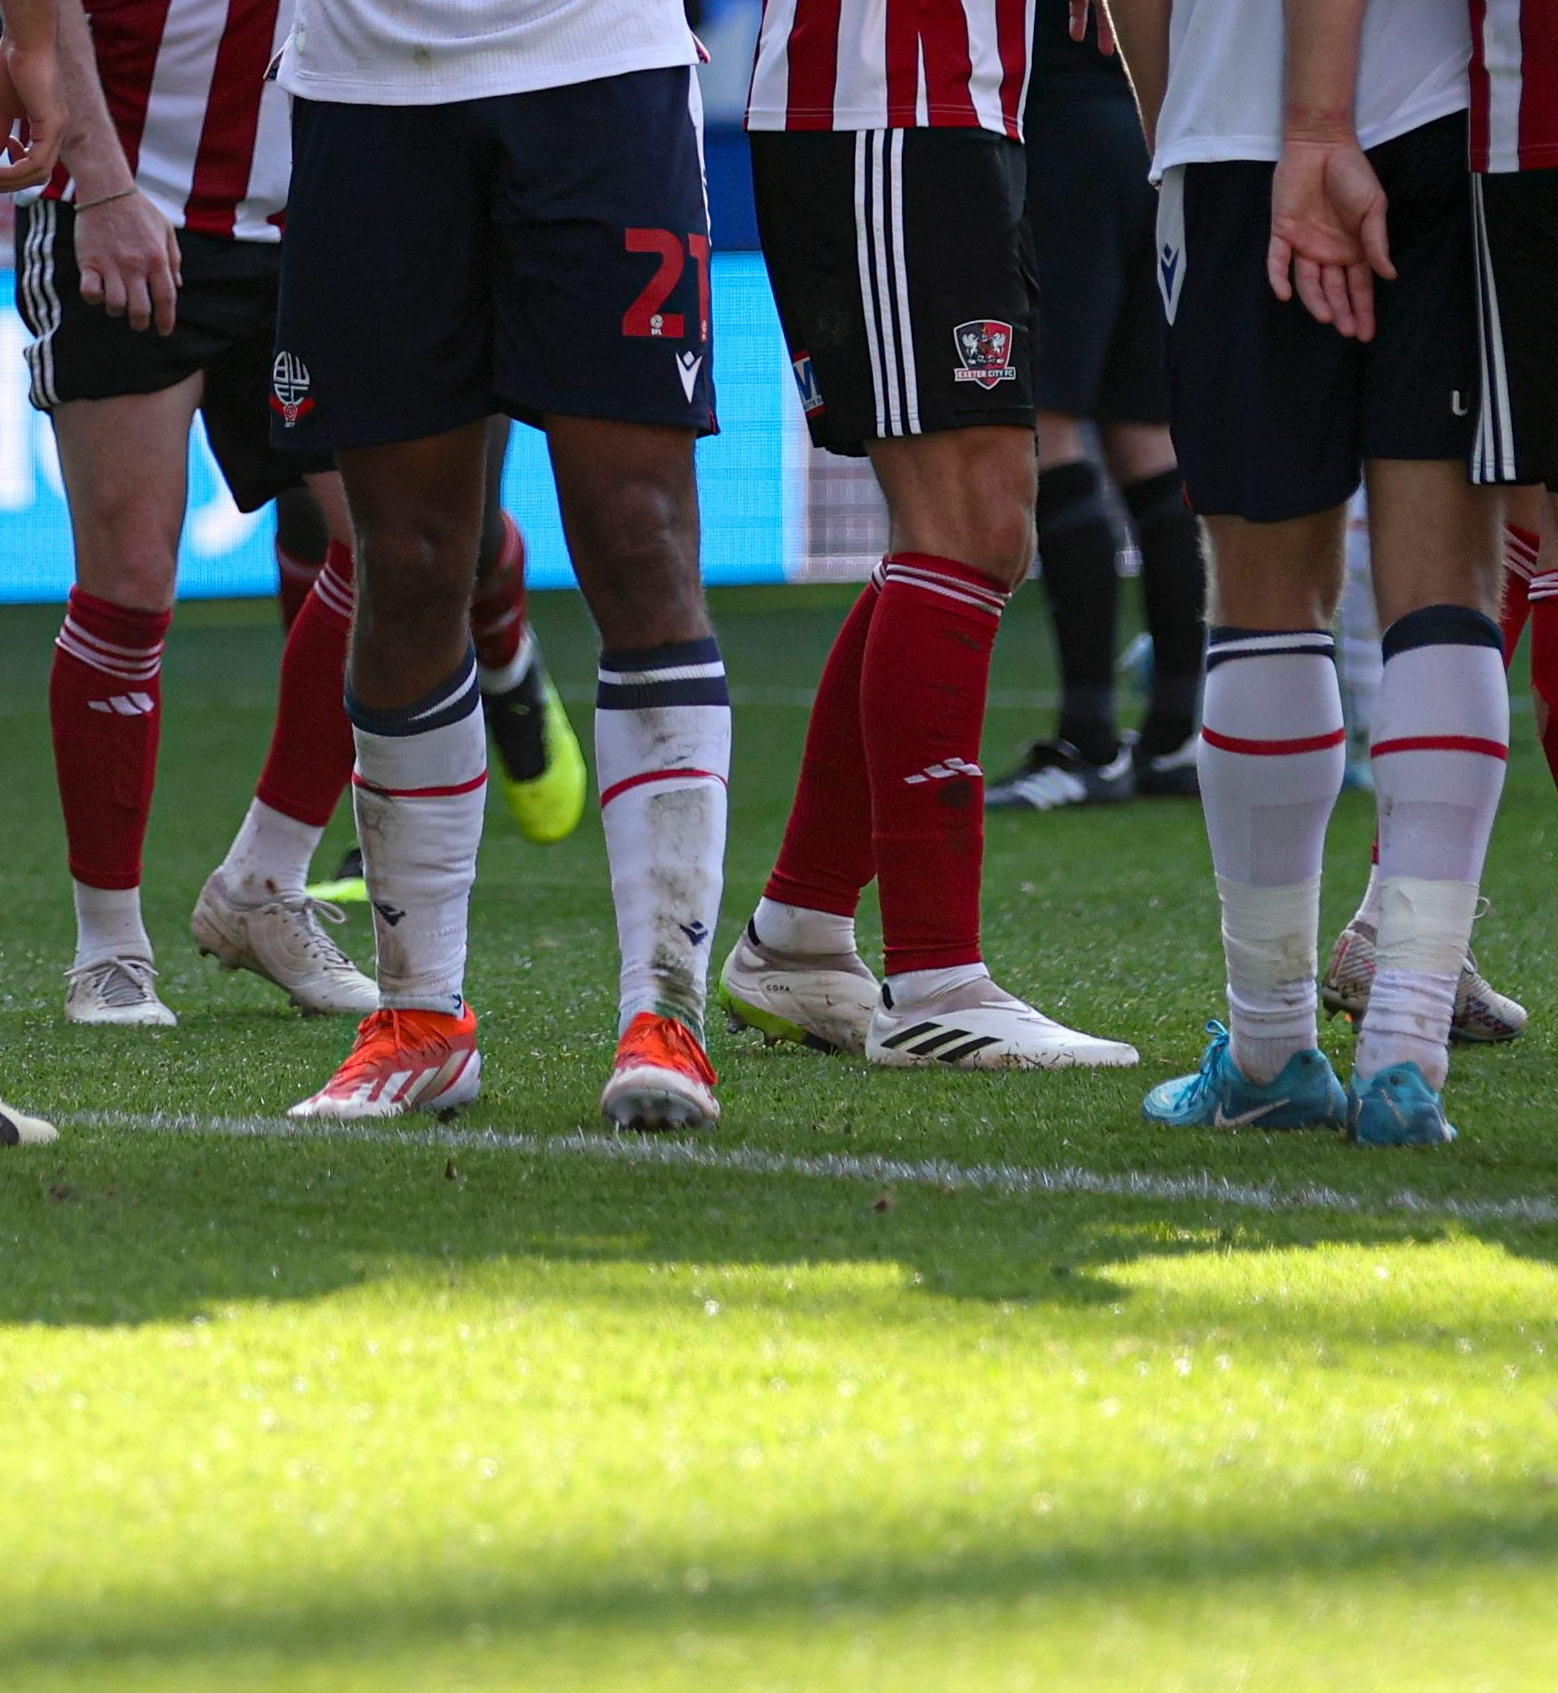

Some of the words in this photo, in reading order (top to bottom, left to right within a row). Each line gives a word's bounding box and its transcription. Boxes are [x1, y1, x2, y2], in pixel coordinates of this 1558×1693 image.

[621, 227, 710, 343] 21
[957, 370, 987, 378] EXETER
[1004, 369, 1013, 377] FC
[766, 984, 791, 992] COPA
